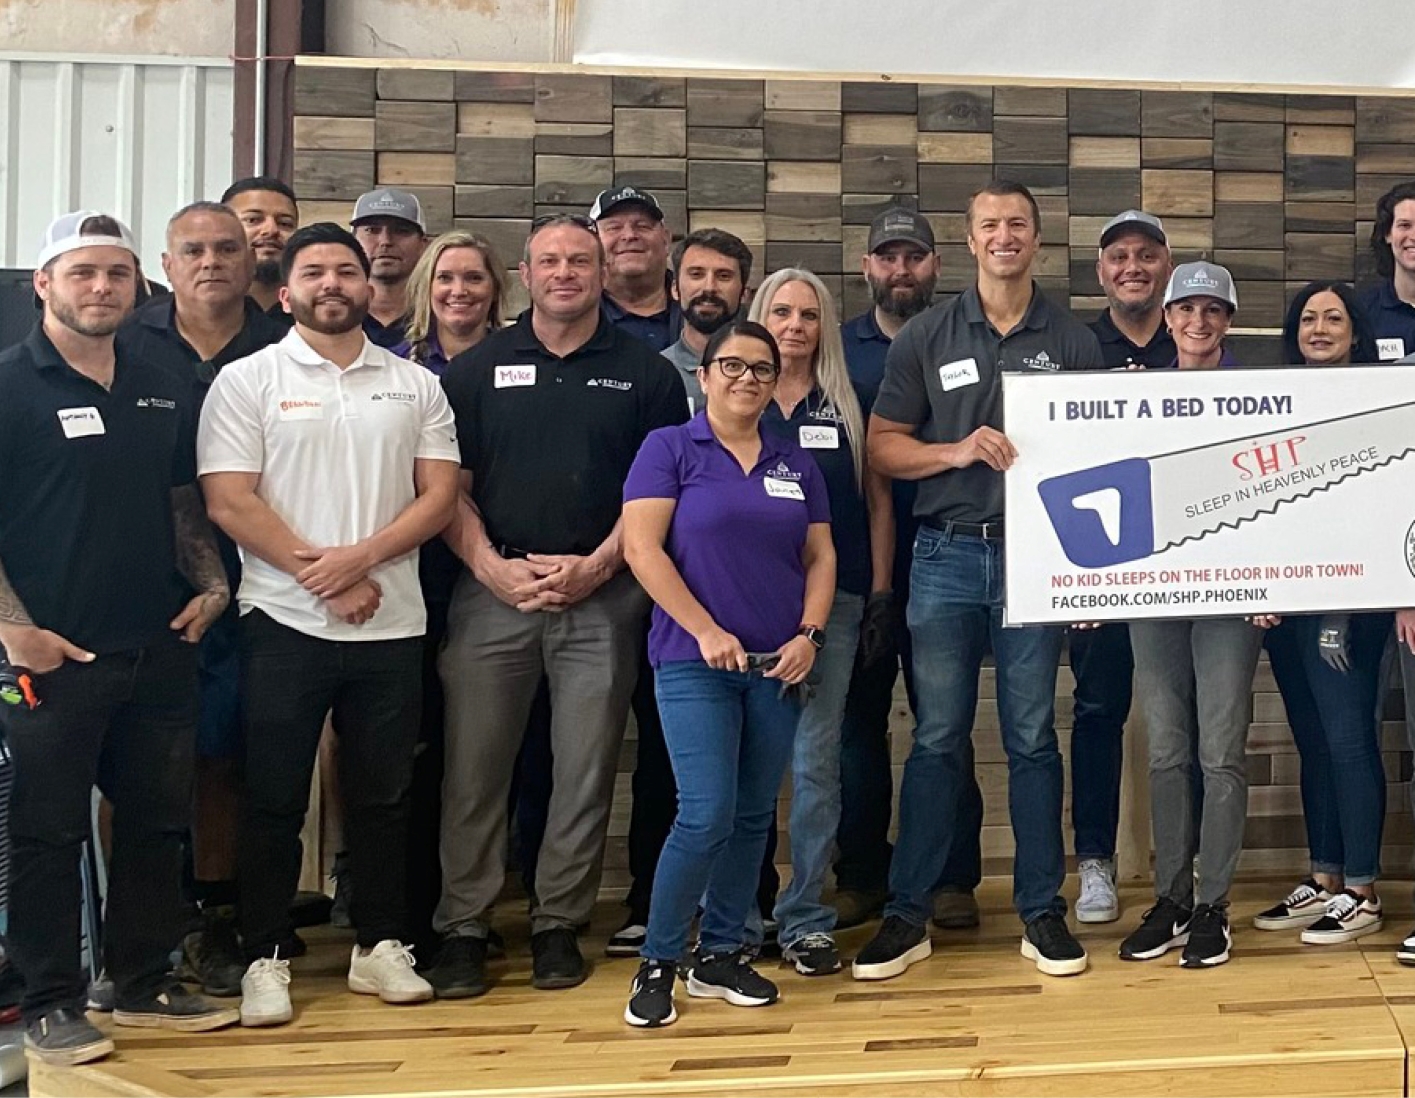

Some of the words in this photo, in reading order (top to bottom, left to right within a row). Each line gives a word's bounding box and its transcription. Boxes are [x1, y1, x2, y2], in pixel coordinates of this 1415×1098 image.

[1023, 357, 1060, 369] CENTURY
[500, 370, 532, 382] Mike
[598, 379, 632, 389] CENTURY
[1049, 401, 1055, 421] I
[1065, 400, 1128, 420] BUILT
[1137, 399, 1153, 418] A
[1162, 398, 1205, 418] BED
[1213, 395, 1292, 416] TODAY!
[1232, 435, 1307, 481] SHP
[767, 469, 802, 477] CENTURY
[1184, 493, 1232, 518] SLEEP
[1235, 487, 1250, 502] IN
[1252, 462, 1326, 497] HEAVENLY
[1329, 446, 1379, 472] PEACE
[1051, 574, 1073, 588] NO
[1076, 573, 1102, 587] KID
[1105, 571, 1156, 585] SLEEPS
[1159, 570, 1181, 583] ON
[1184, 569, 1212, 582] THE
[1215, 567, 1262, 581] FLOOR
[1265, 566, 1279, 580] IN
[1283, 565, 1314, 579] OUR
[1316, 563, 1364, 577] TOWN!
[1051, 588, 1268, 609] FACEBOOK.COM/SHP.PHOENIX
